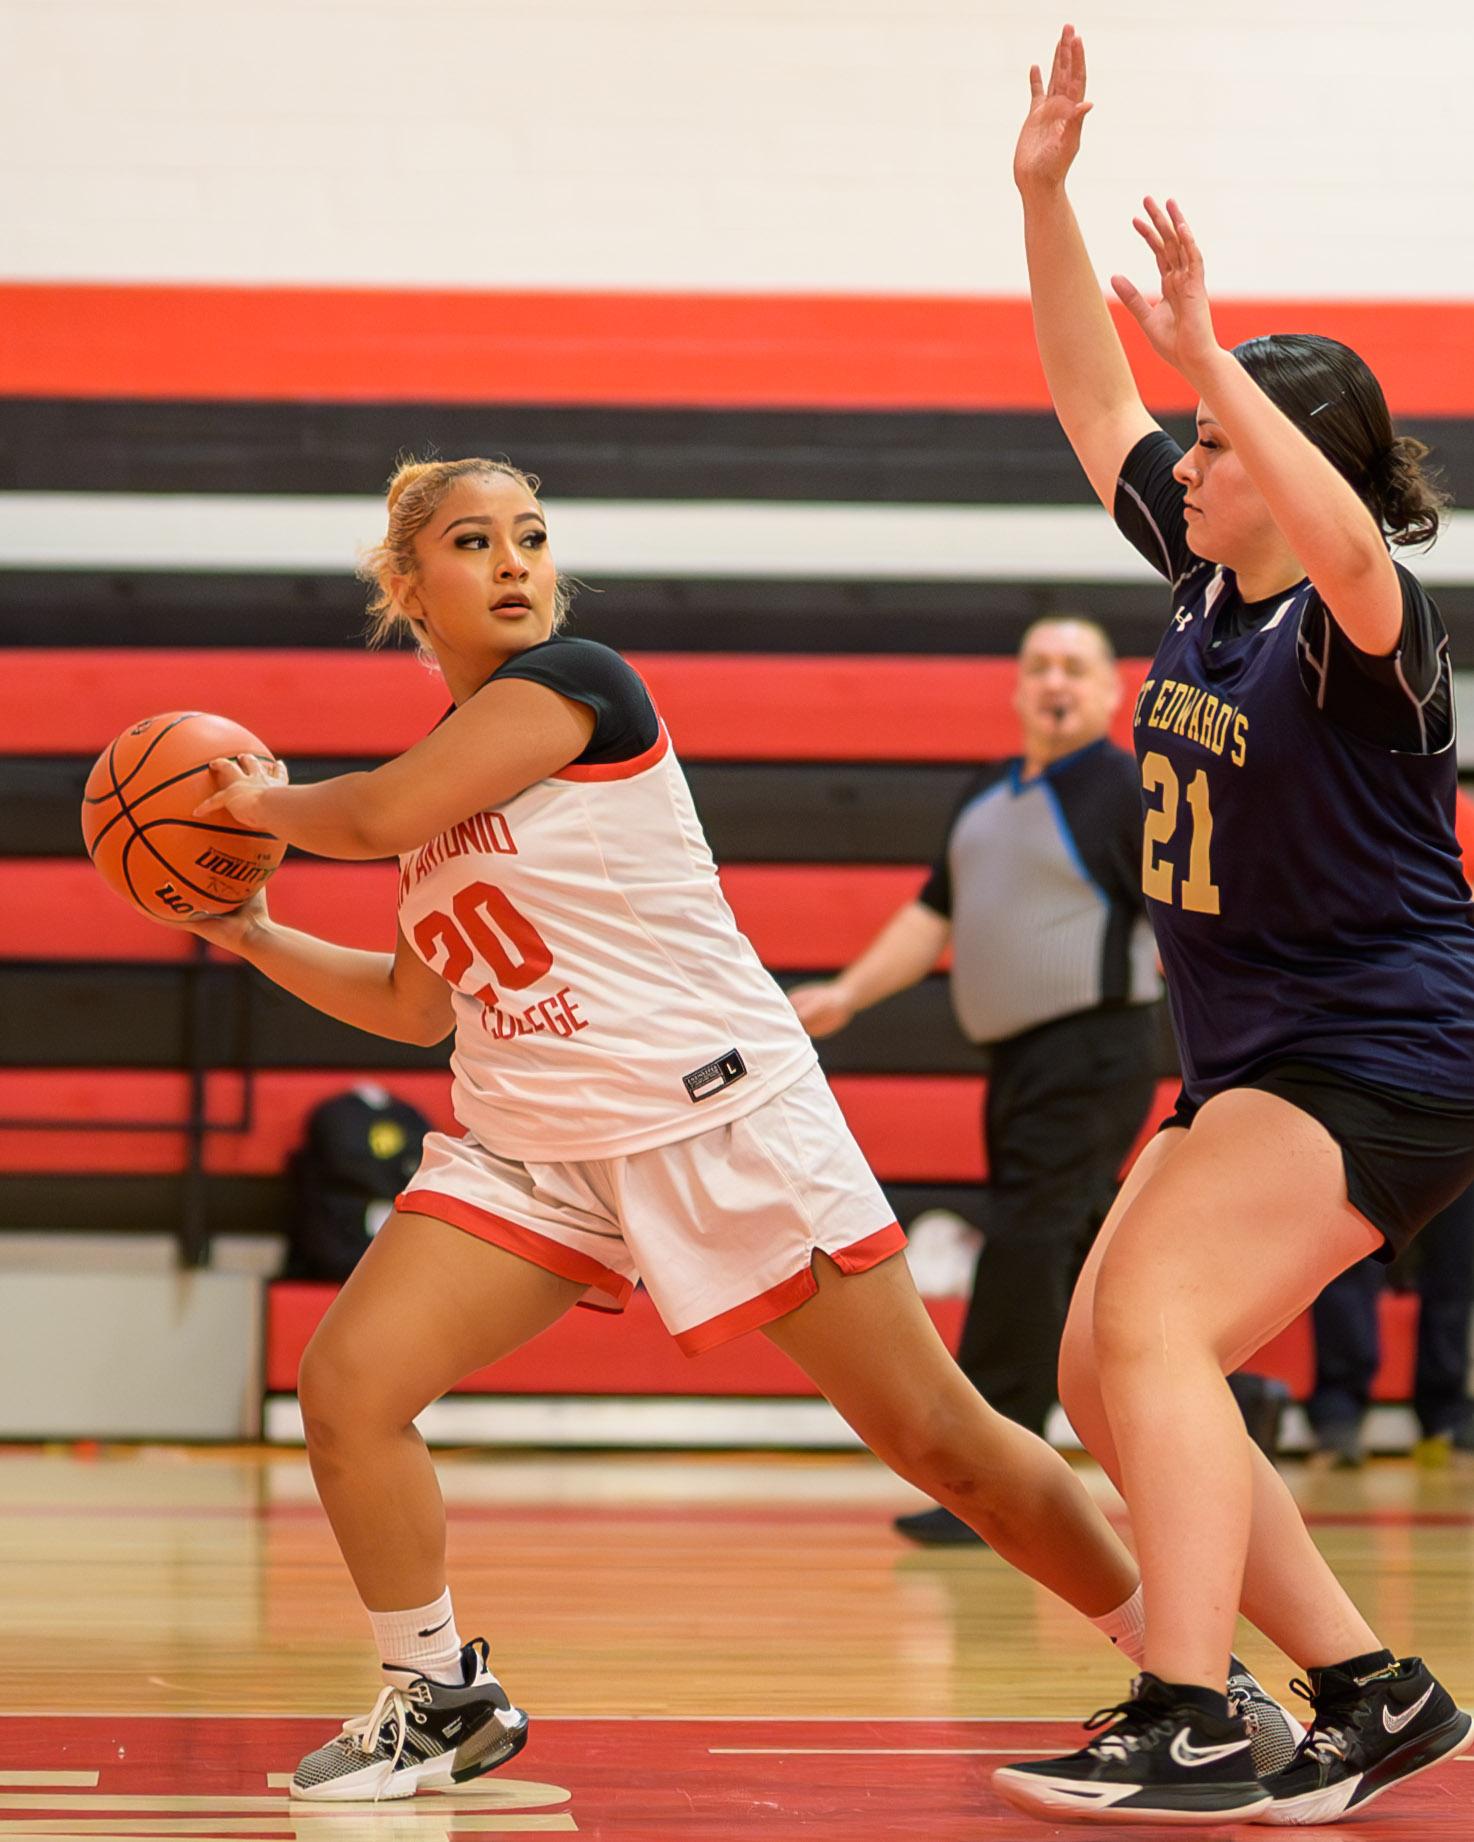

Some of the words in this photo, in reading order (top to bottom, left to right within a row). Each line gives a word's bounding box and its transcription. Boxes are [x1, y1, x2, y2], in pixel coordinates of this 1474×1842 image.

[1148, 679, 1249, 768] EDWARD'S
[415, 812, 519, 884] ANTONIO
[1142, 751, 1221, 916] 21
[413, 881, 554, 1007] 20
[726, 1061, 738, 1077] L
